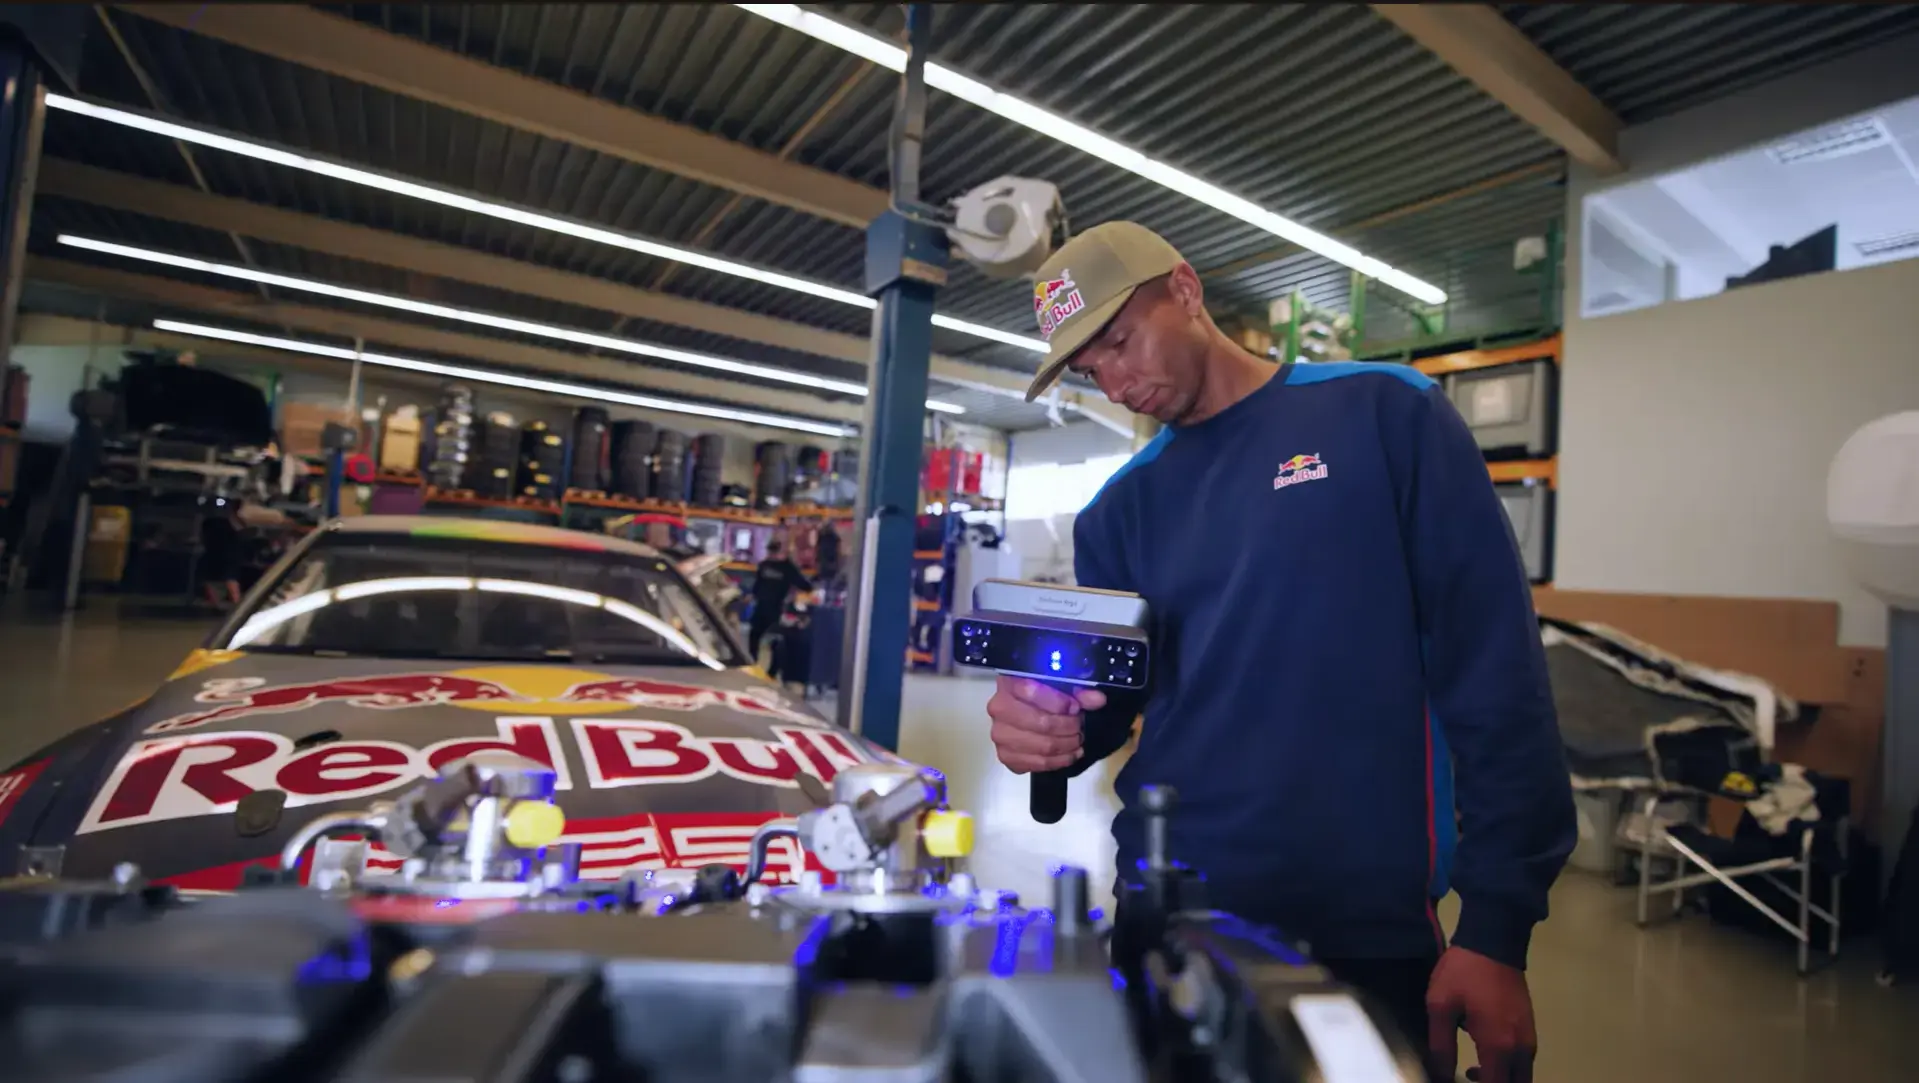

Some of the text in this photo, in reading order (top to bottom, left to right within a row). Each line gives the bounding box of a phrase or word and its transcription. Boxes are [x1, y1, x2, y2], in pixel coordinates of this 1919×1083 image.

[1051, 289, 1085, 325] Bull
[1300, 464, 1328, 482] Bull
[76, 717, 868, 835] Red Bull
